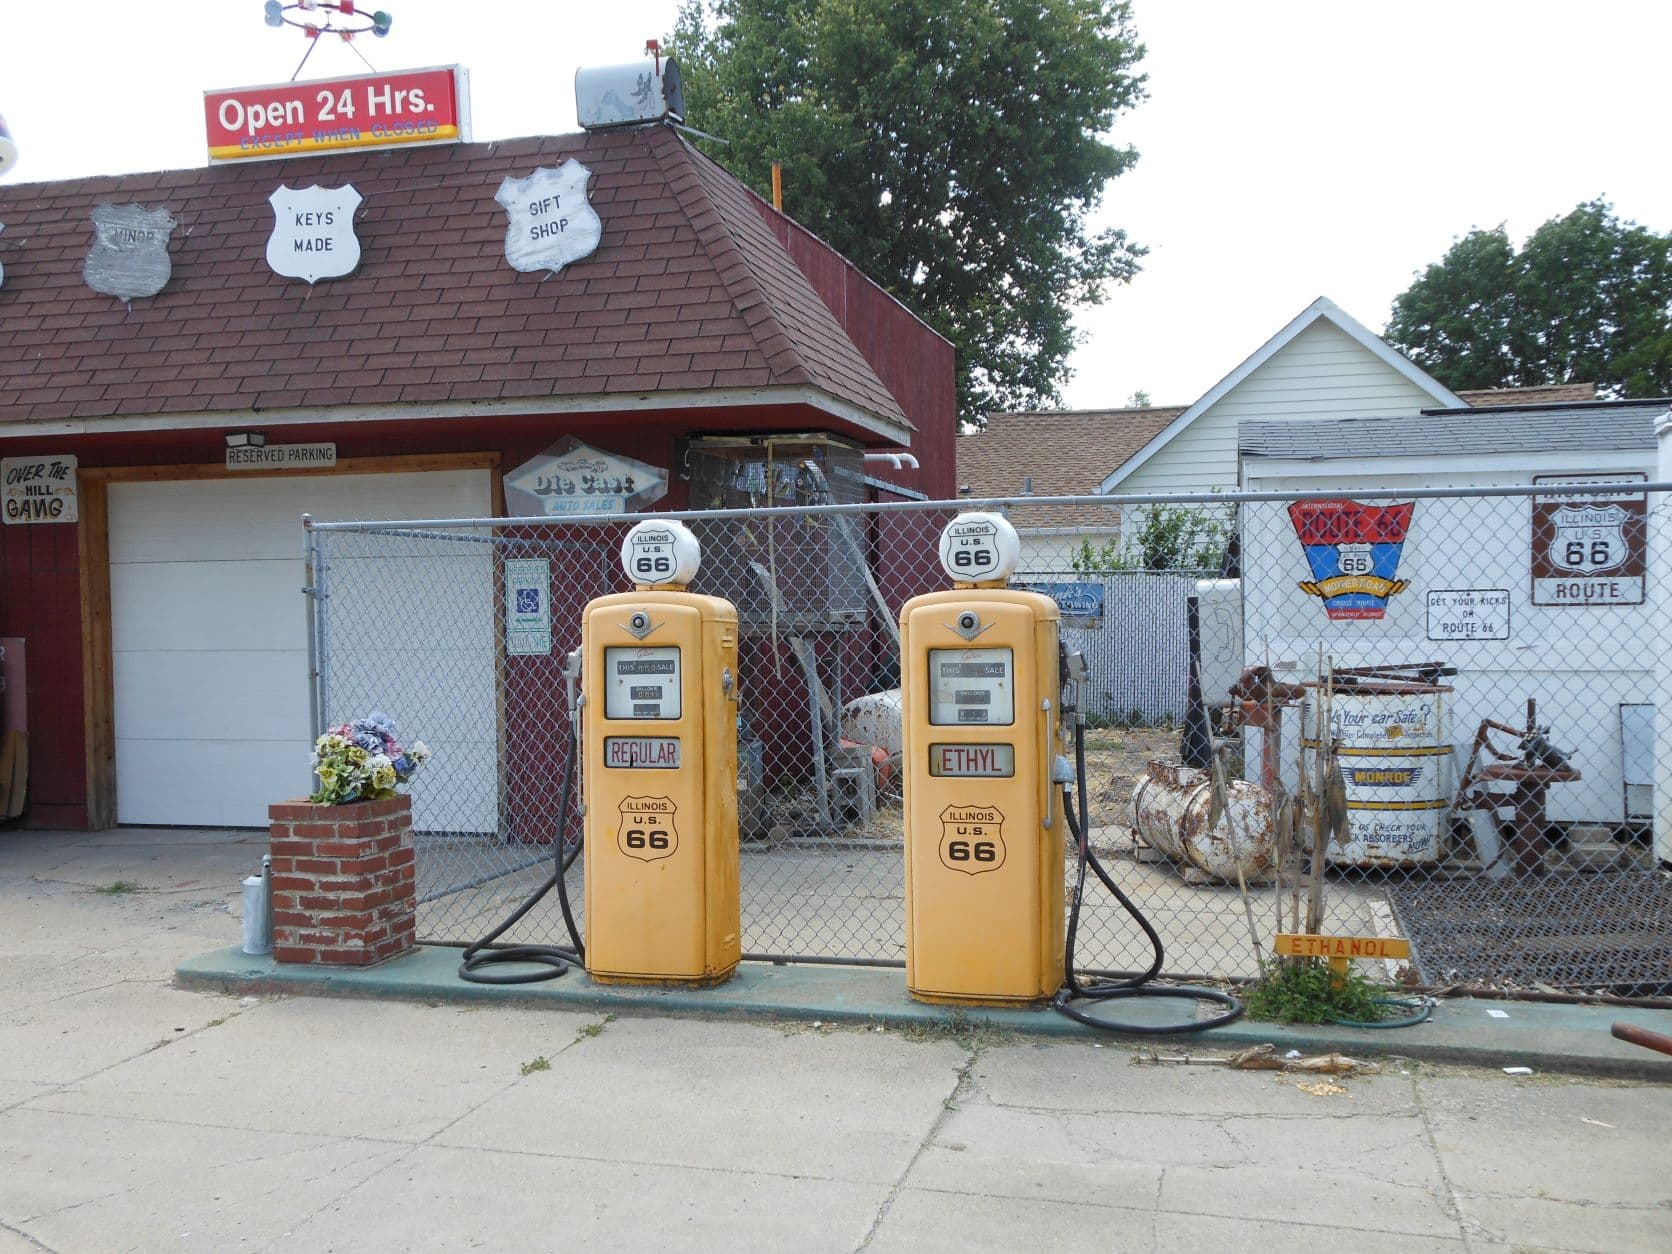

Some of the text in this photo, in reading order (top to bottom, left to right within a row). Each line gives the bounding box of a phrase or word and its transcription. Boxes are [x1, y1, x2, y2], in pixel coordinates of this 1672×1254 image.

[219, 84, 435, 137] Open 24 Hrs.
[240, 119, 439, 151] EXCEPT WHEN CLOSED
[529, 194, 561, 216] GIFT
[295, 212, 334, 227] KEYS
[530, 218, 569, 240] SHOP
[294, 237, 334, 253] MADE
[229, 447, 333, 464] RESERVED PARKING
[6, 461, 71, 485] OVER THE
[25, 484, 54, 497] HILL
[534, 472, 635, 495] Die Cast
[7, 497, 64, 519] GANG
[552, 498, 615, 512] AUTO SALES
[1302, 510, 1402, 539] ROUTE 66
[1561, 512, 1617, 524] ILLINOIS
[954, 525, 990, 535] ILLINOIS
[637, 534, 670, 543] ILLINOIS
[960, 538, 985, 546] U.S.
[642, 545, 665, 553] U.S.
[1565, 541, 1610, 566] 66
[636, 556, 670, 573] 66
[954, 549, 992, 567] 66
[1343, 558, 1368, 572] 66
[1323, 579, 1387, 593] MOTHER ROAD
[1556, 582, 1620, 599] ROUTE
[1061, 600, 1098, 610] TOWING
[1430, 596, 1507, 606] GET YOUR KICKS
[1462, 610, 1474, 618] ON
[1442, 622, 1494, 633] ROUTE 66
[619, 663, 636, 671] THIS
[657, 662, 674, 671] SALE
[942, 665, 1005, 674] THIS SALE
[1342, 709, 1369, 724] Your
[1371, 713, 1394, 724] car
[611, 741, 676, 764] REGULAR
[942, 748, 1003, 772] ETHYL
[1354, 770, 1412, 784] MONROE
[627, 802, 668, 811] ILLINOIS
[633, 816, 662, 825] U.S.
[949, 811, 995, 821] ILLINOIS
[956, 826, 988, 836] U.S.
[1358, 823, 1371, 831] US
[1374, 823, 1402, 832] CHECK
[1406, 823, 1427, 831] YOUR
[626, 829, 669, 850] 66
[1363, 832, 1414, 843] ABSORBERS
[948, 841, 996, 862] 66
[1290, 938, 1389, 957] ETHANOL
